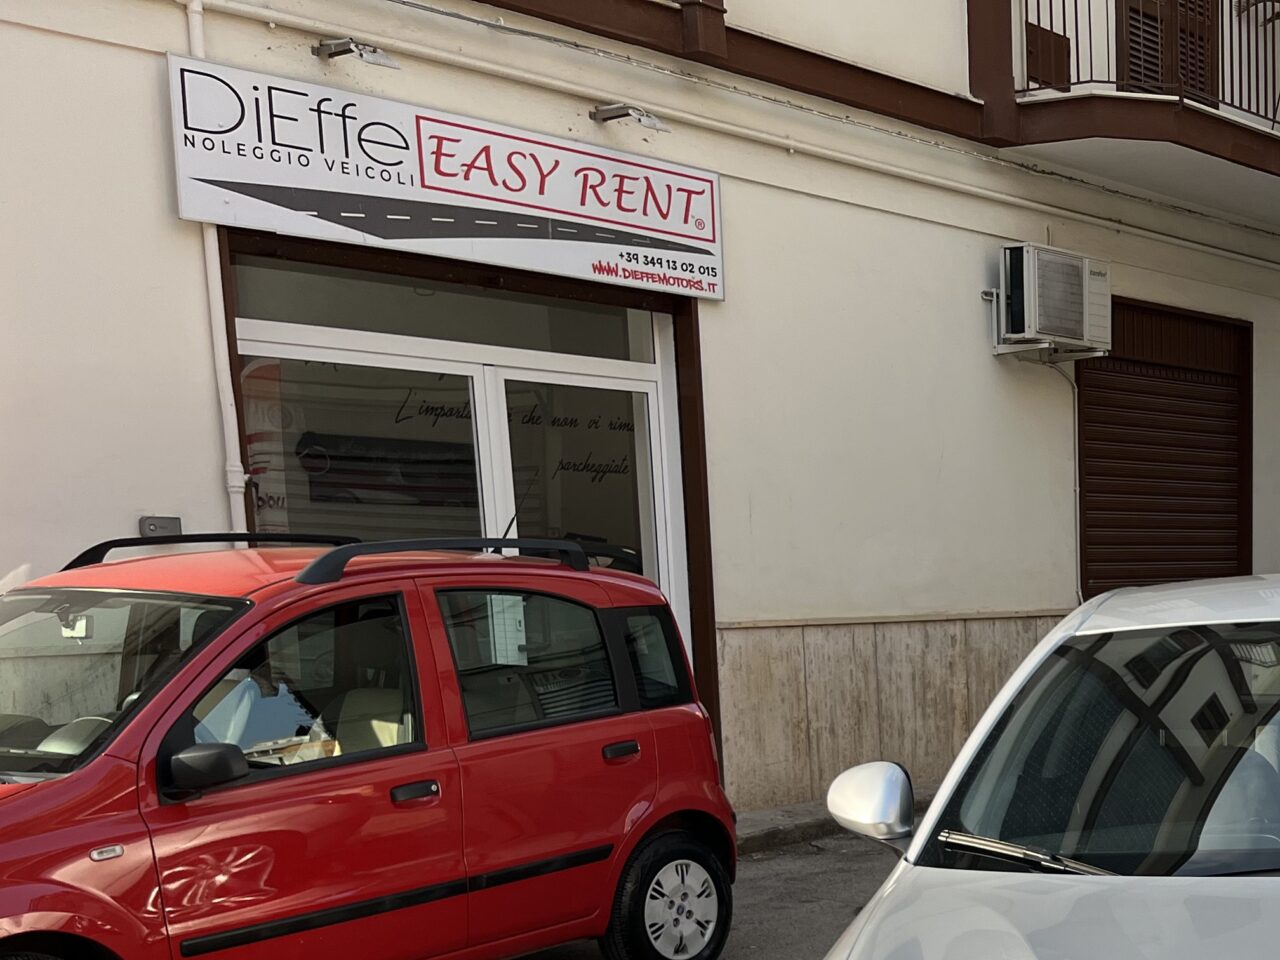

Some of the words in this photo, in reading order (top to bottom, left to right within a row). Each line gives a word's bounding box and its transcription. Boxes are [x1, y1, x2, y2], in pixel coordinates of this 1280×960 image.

[180, 68, 410, 166] DiEffe
[184, 133, 310, 167] NOLEGGIO
[324, 158, 414, 187] VEICOLI
[428, 135, 560, 195] EASY
[619, 251, 639, 264] +39
[643, 255, 663, 268] 349
[666, 259, 678, 270] 13
[681, 263, 695, 273] 02
[698, 265, 717, 277] 015
[522, 405, 542, 425] che
[552, 416, 579, 428] non
[588, 415, 600, 429] vi
[552, 452, 629, 482] parcheggiate
